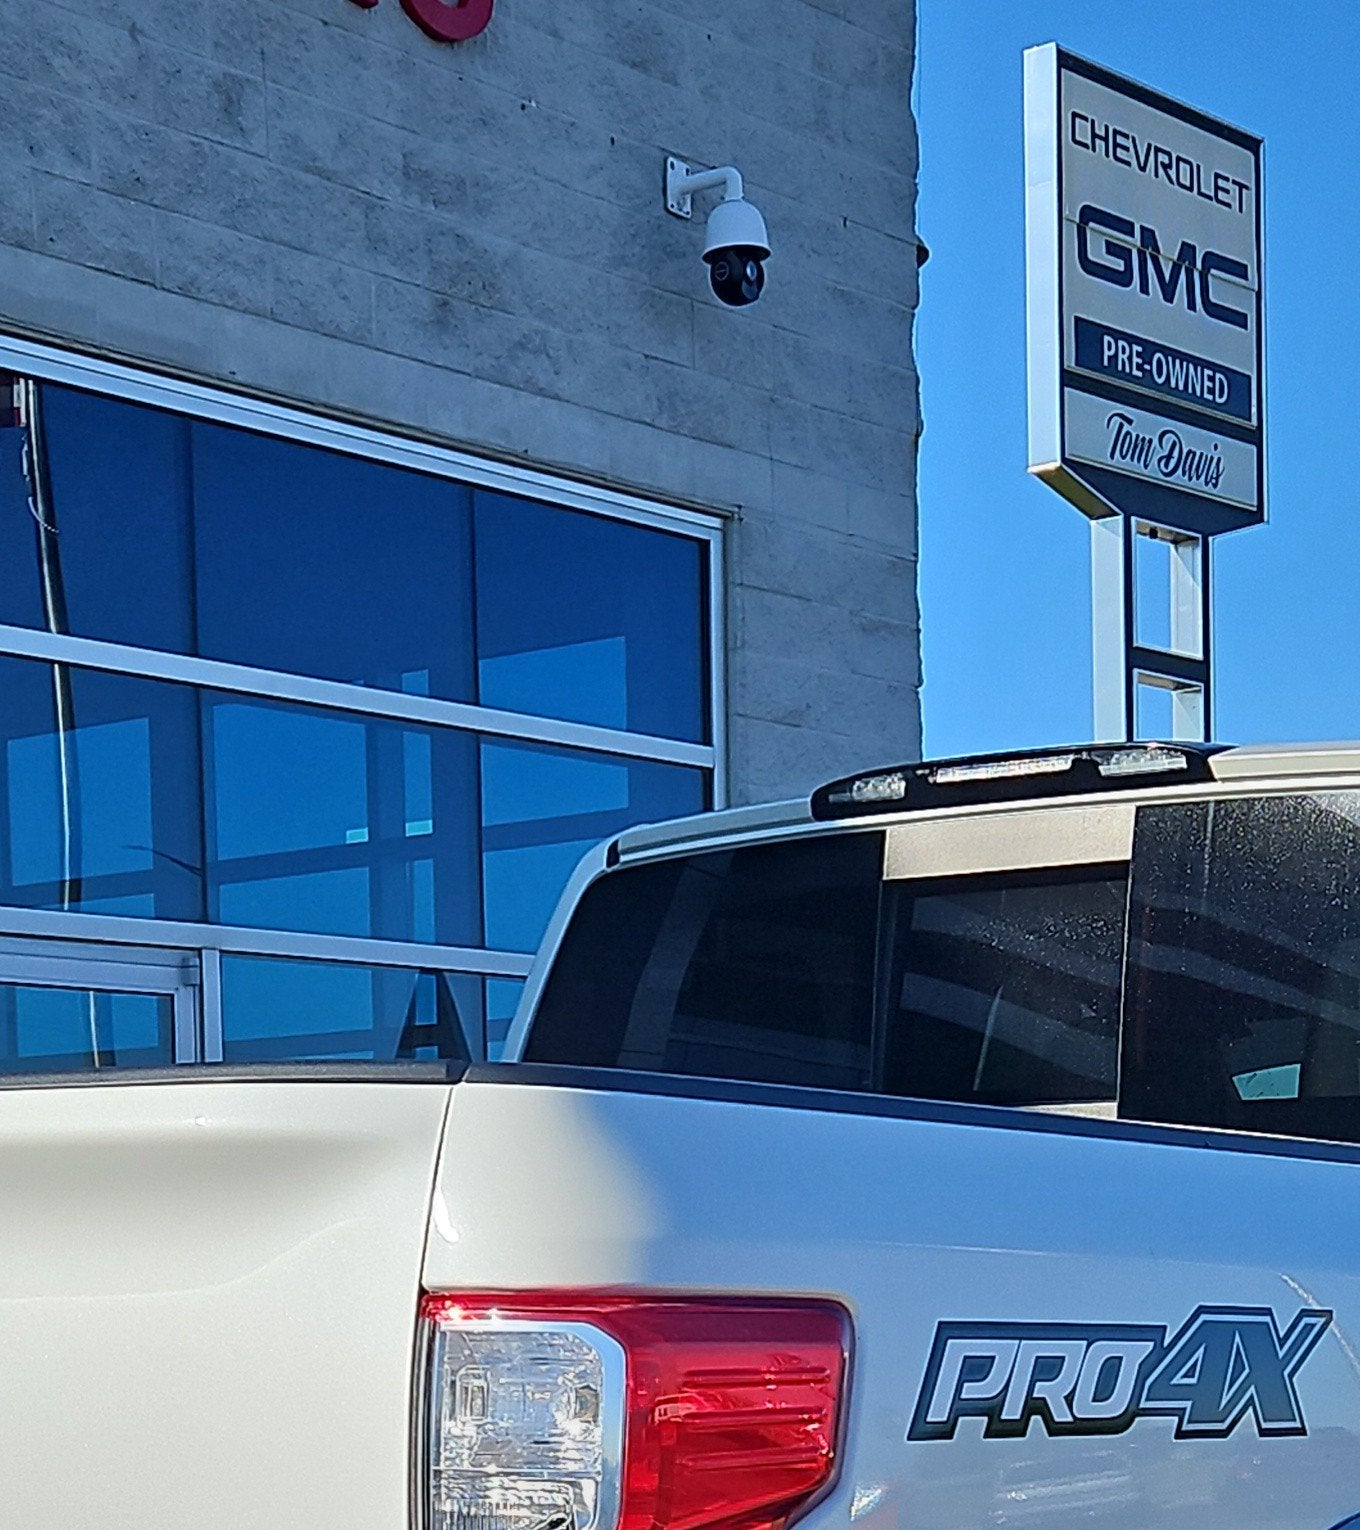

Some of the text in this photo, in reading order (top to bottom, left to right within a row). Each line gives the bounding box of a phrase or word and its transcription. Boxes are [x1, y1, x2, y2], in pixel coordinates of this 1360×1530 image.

[1070, 110, 1250, 214] CHEVROLET
[1076, 203, 1249, 332] GMC
[1102, 334, 1229, 404] PRE-OWNED
[1106, 411, 1225, 490] Tom Davis
